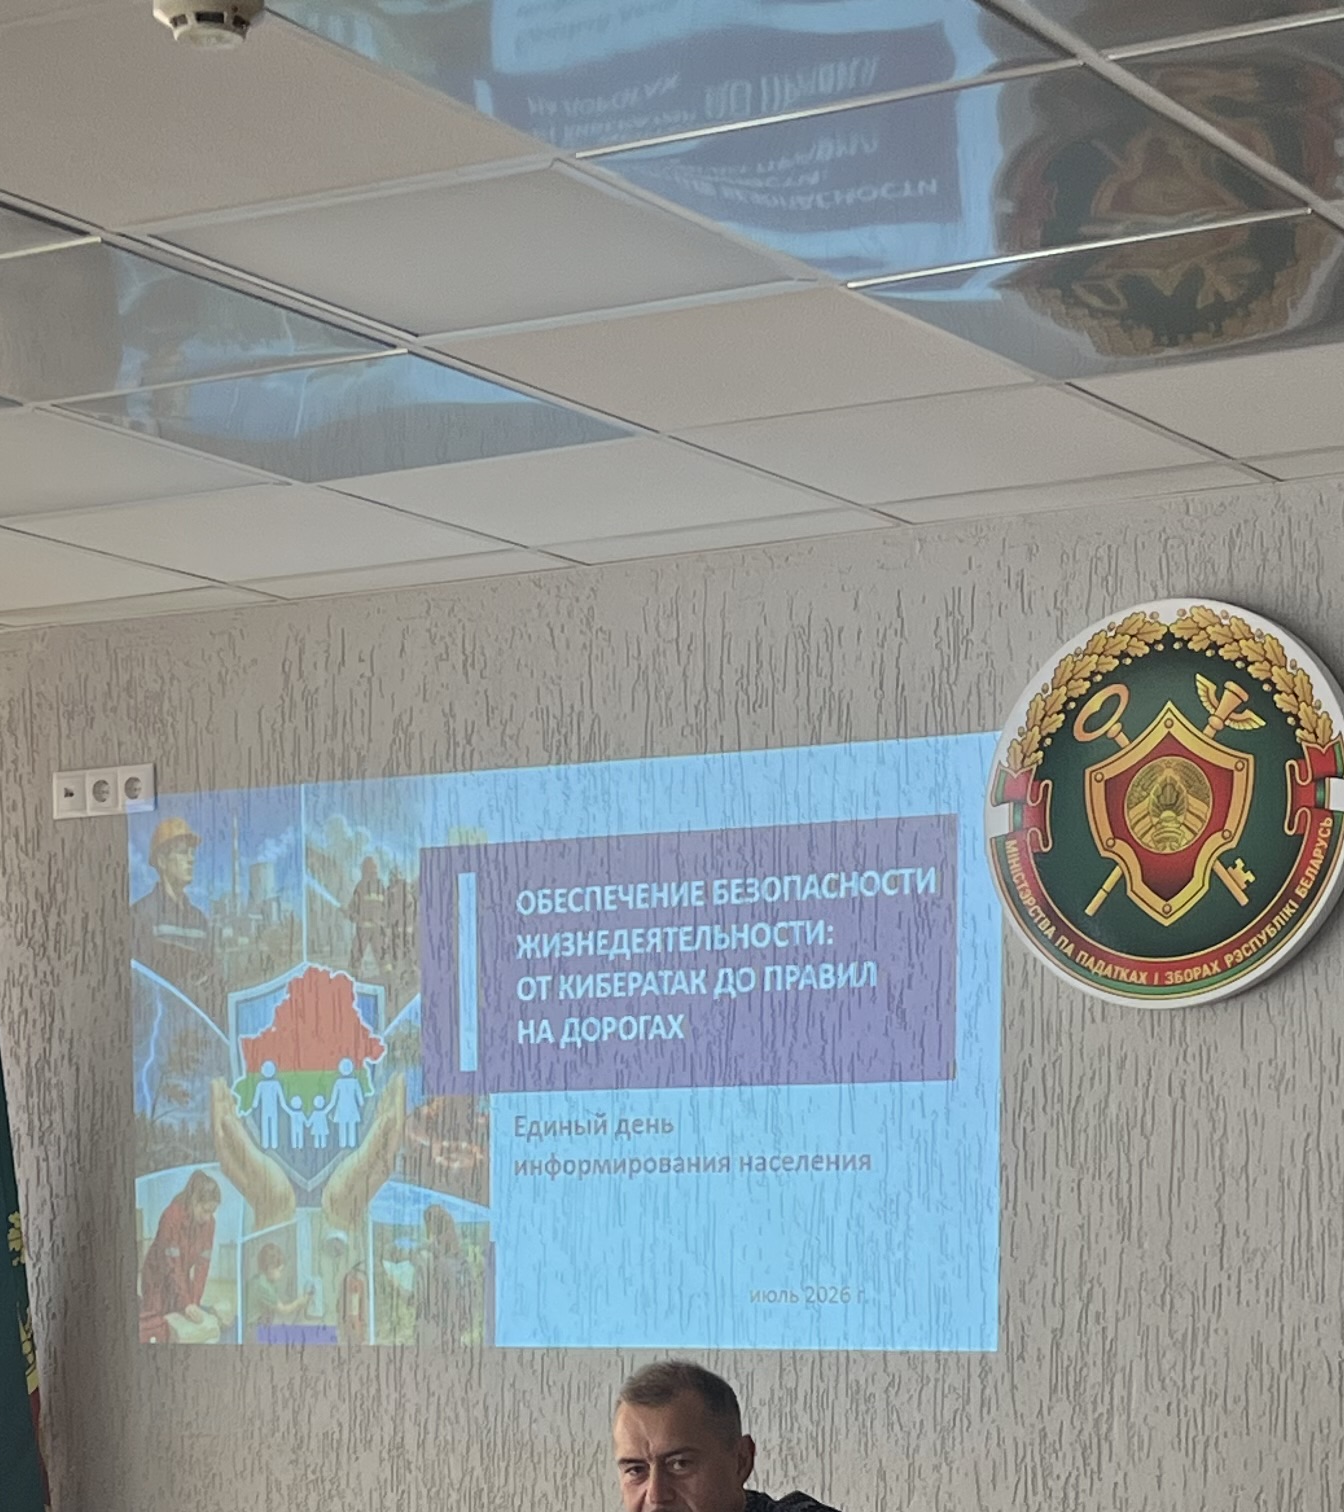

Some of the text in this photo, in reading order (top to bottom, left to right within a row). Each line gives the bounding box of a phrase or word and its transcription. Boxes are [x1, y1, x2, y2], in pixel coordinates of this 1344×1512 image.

[516, 866, 937, 916] ОБЕСПЕЧЕНИЕ БЕЗОПАСНОСТИ
[1005, 838, 1057, 939] МІНІСТЭРСТВА
[1055, 935, 1076, 957] ПА
[1076, 951, 1149, 984] ПАДАТКАХ
[1164, 962, 1221, 985] ЗБОРАХ
[1224, 899, 1300, 968] РЭСПУБЛІКІ
[1294, 816, 1334, 899] БЕЛАРУСЬ
[516, 919, 835, 960] ЖИЗНЕДЕЯТЕЛЬНОСТИ:
[516, 961, 878, 1001] ОТ КИБЕРАТАК ДО ПРАВИЛ
[517, 1014, 686, 1048] НА ДОРОГАХ
[513, 1113, 675, 1143] Единый день
[513, 1152, 872, 1180] информирования населения
[749, 1287, 799, 1305] июль
[804, 1285, 852, 1304] 2026
